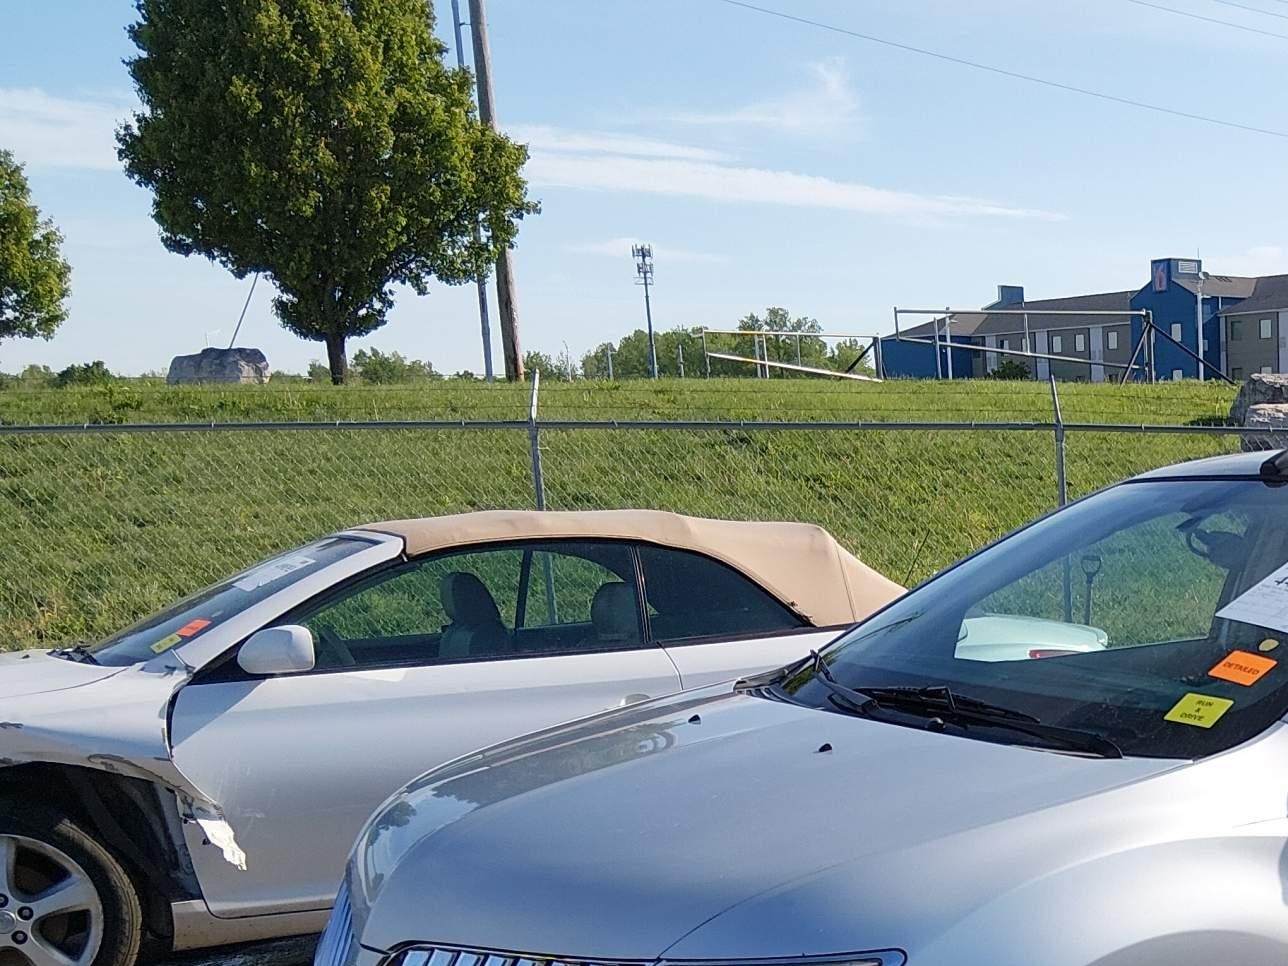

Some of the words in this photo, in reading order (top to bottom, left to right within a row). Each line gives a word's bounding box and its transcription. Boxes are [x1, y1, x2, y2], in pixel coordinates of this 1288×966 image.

[1222, 661, 1260, 676] DETAILED
[1195, 699, 1214, 708] RUN
[1179, 711, 1205, 722] DRIVE
